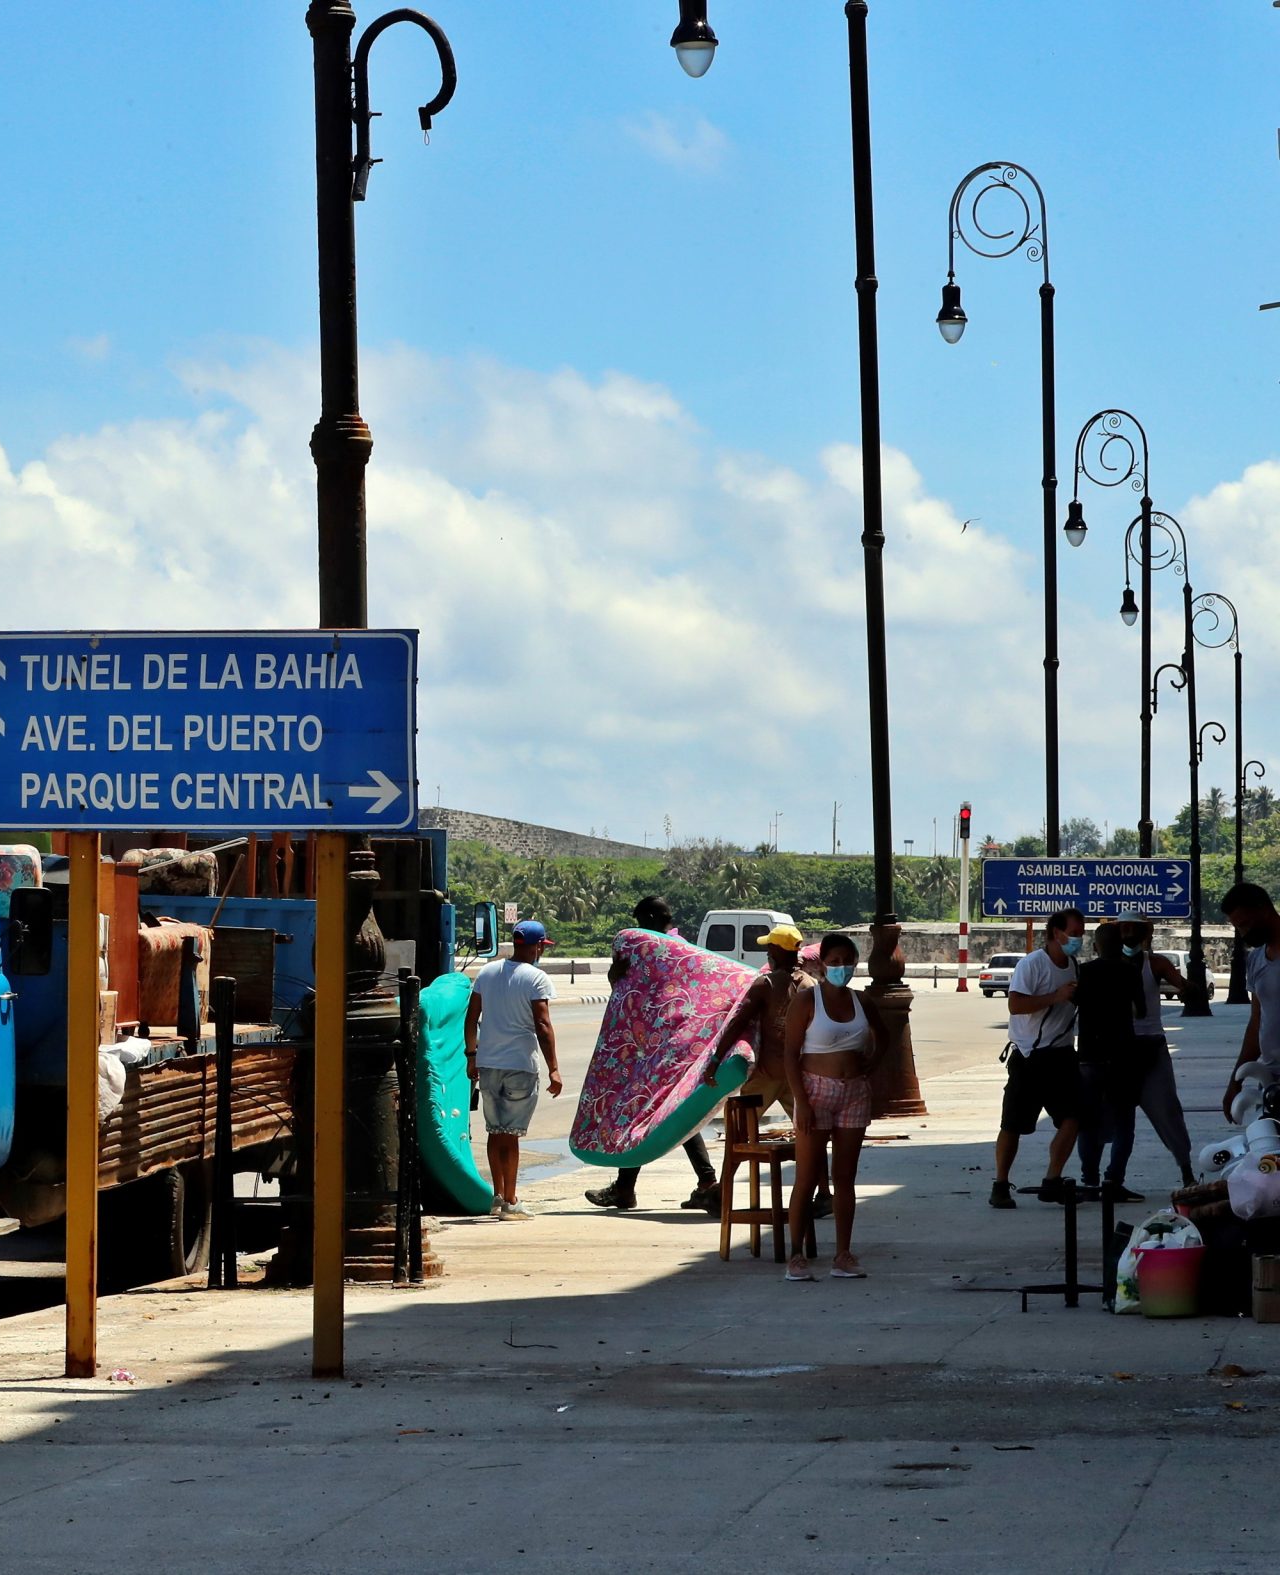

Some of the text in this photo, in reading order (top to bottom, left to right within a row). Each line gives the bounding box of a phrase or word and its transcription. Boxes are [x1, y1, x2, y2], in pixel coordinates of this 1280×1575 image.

[20, 653, 363, 691] TUNEL DE LA BAHIA
[21, 714, 323, 752] AVE. DEL PUERTO
[21, 772, 332, 812] PARQUE CENTRAL
[1017, 864, 1158, 877] ASAMBLEA NACIONAL
[1018, 883, 1163, 896] TRIBUNAL PROVINCIAL
[1088, 900, 1105, 913] DE
[1113, 901, 1162, 913] TRENES
